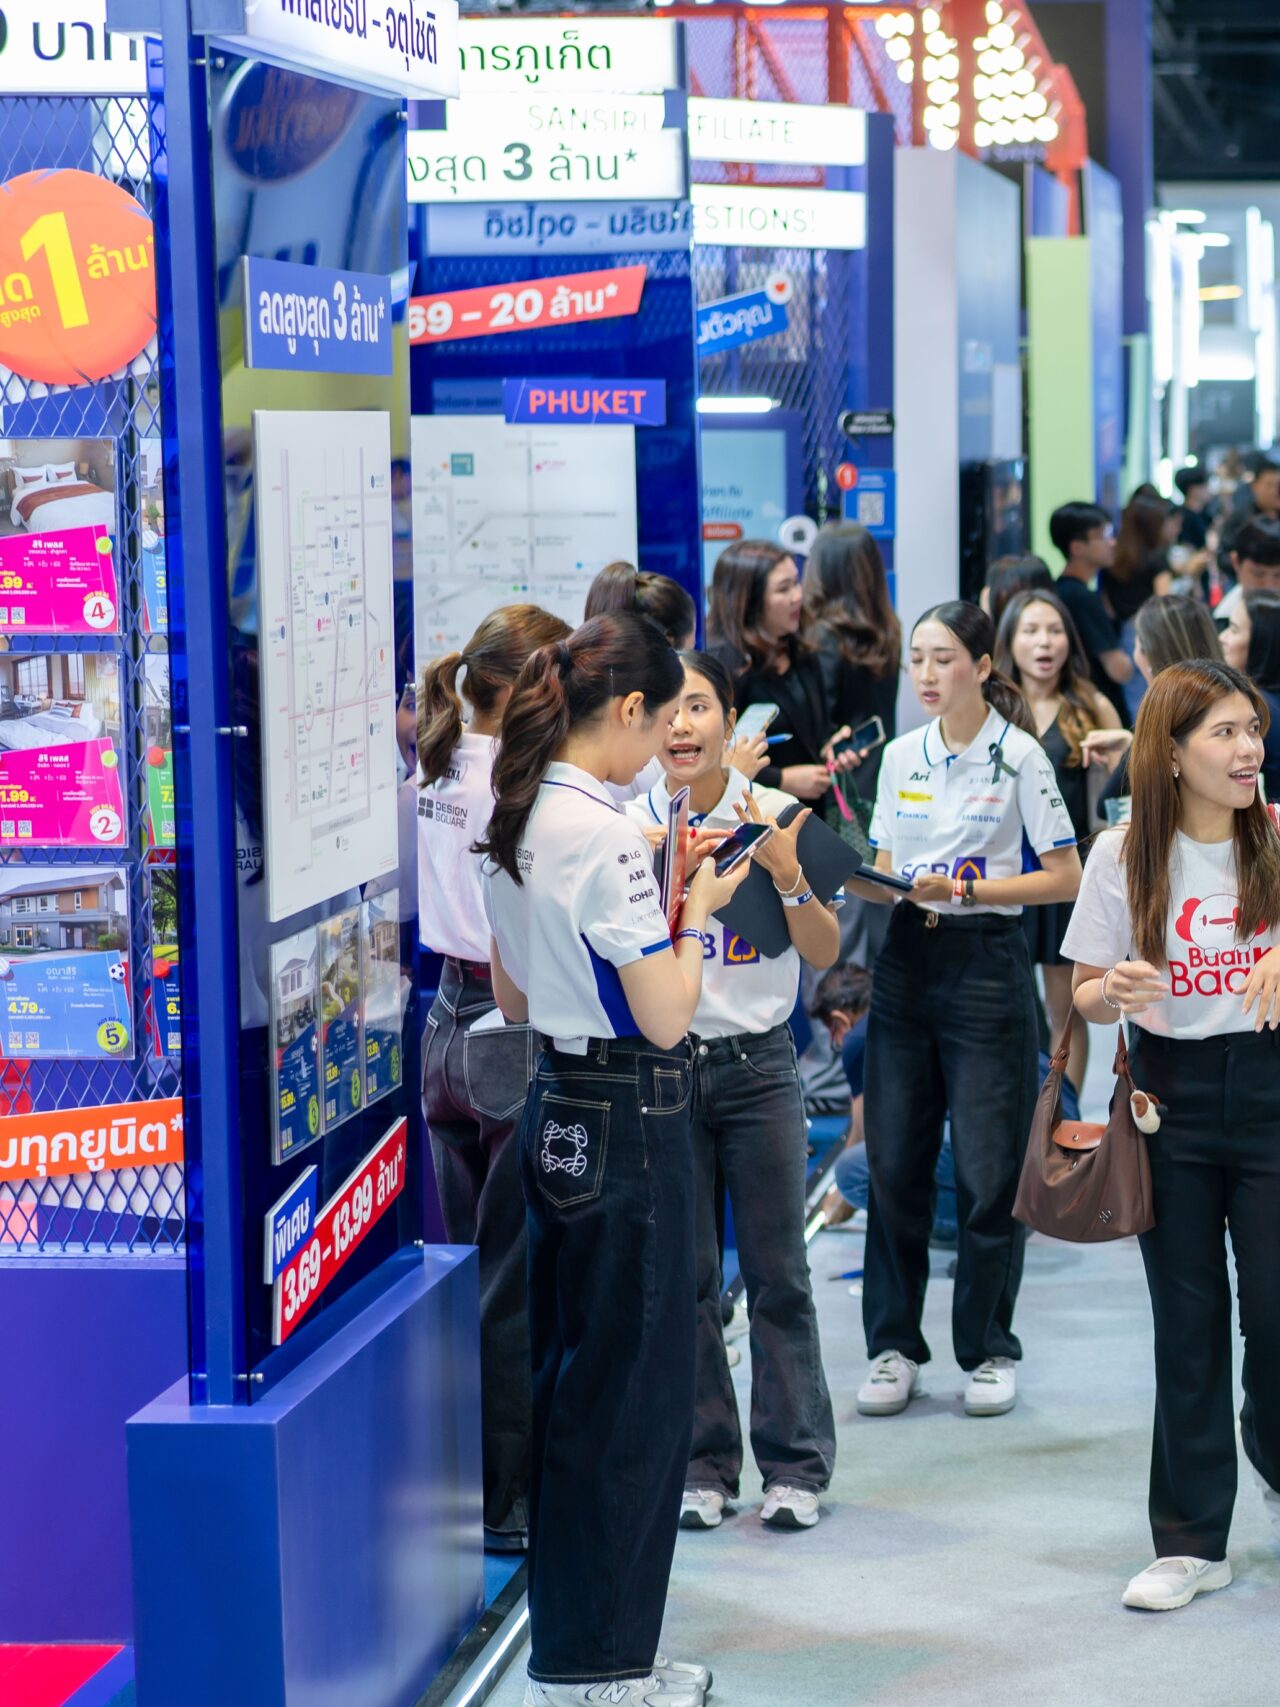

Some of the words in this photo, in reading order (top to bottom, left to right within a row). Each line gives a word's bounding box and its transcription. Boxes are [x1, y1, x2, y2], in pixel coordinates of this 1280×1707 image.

[691, 114, 796, 144] FILIATE
[503, 143, 533, 181] 3
[0, 272, 33, 305] ด
[20, 211, 89, 329] 1
[259, 291, 330, 356] ลดสูงสุด
[333, 281, 348, 340] 3
[490, 290, 543, 323] 20
[529, 389, 647, 415] PHUKET
[91, 602, 106, 619] 4
[909, 771, 931, 782] Ari
[435, 801, 468, 818] DESIGN
[435, 812, 467, 830] SQUARE
[98, 816, 112, 835] 2
[516, 848, 535, 862] SIGN
[106, 1028, 120, 1046] 5
[274, 1197, 310, 1265] พิเศษ
[285, 1238, 321, 1321] 3.69
[332, 1174, 373, 1261] 13.99
[600, 1681, 630, 1704] N
